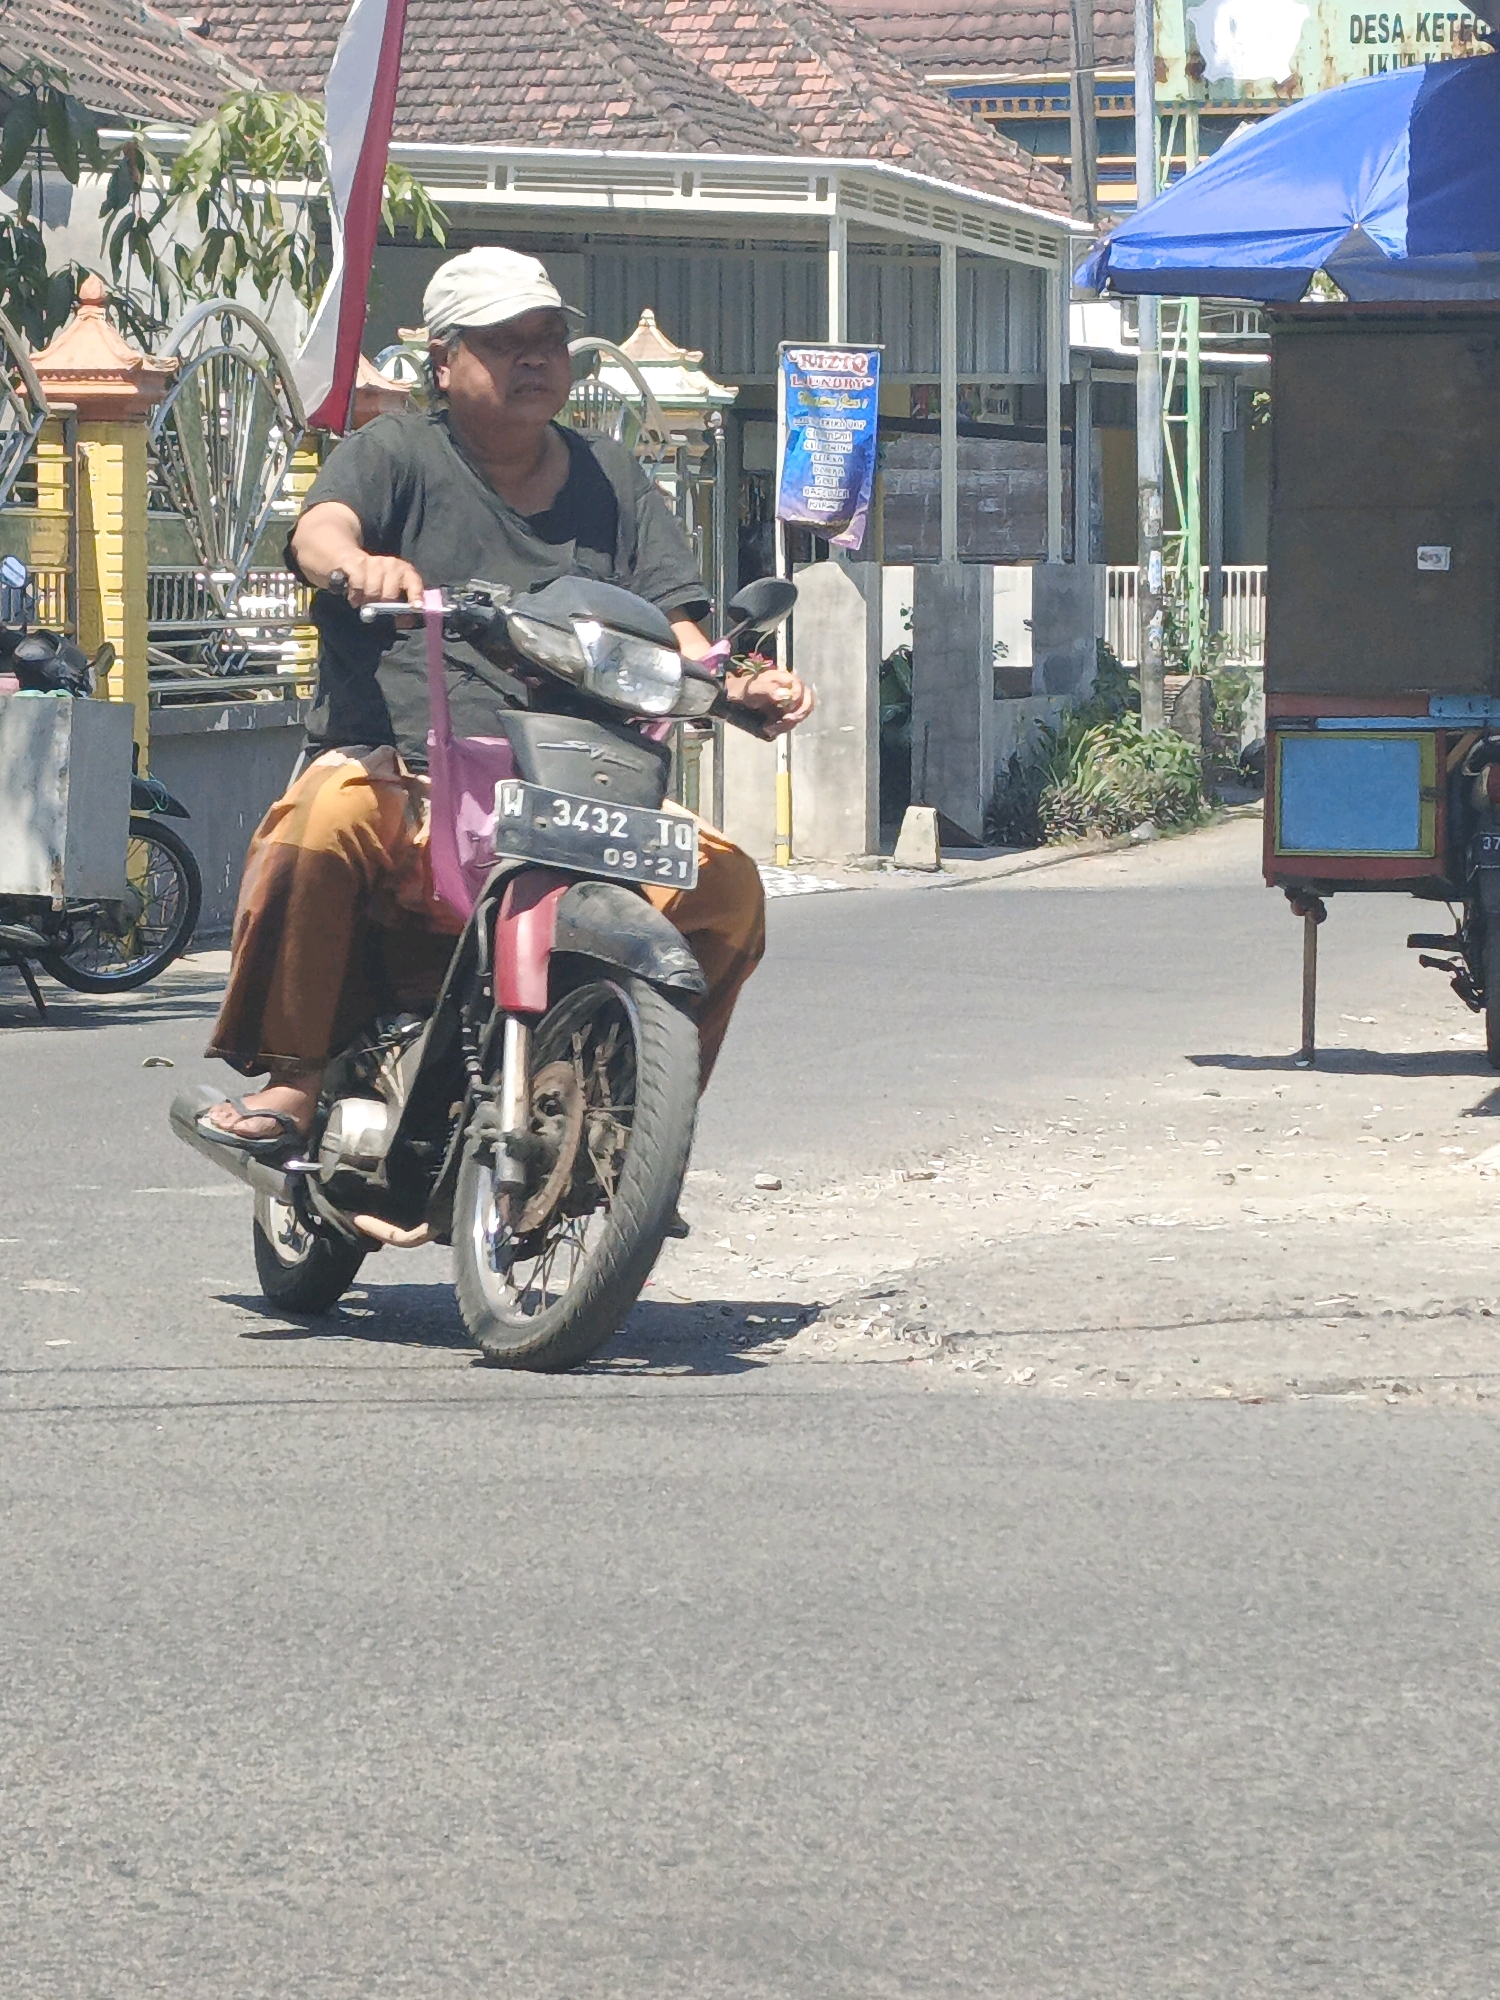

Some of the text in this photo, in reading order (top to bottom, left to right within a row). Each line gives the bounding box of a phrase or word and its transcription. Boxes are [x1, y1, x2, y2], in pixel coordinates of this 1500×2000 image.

[1350, 13, 1405, 44] DESA
[502, 788, 524, 816] W
[552, 799, 629, 838] 3432
